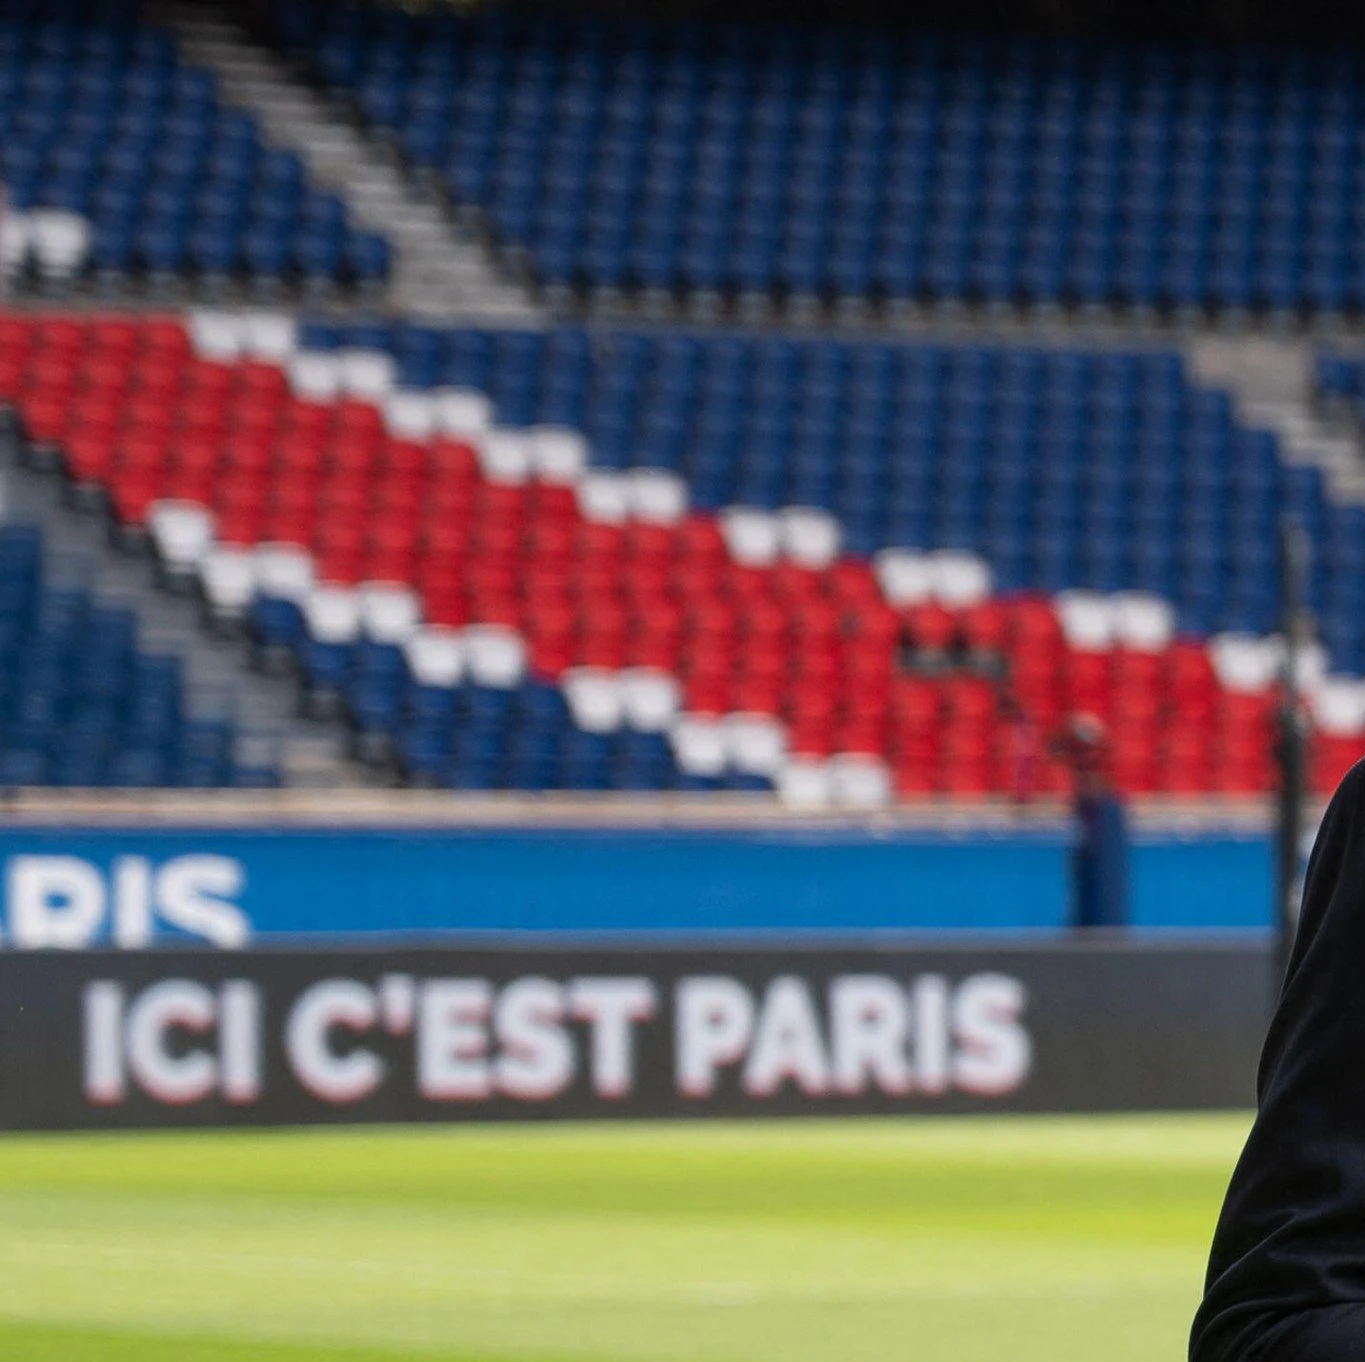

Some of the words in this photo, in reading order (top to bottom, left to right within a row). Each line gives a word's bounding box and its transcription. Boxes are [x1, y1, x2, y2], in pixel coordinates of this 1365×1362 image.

[3, 852, 253, 950] RIS
[83, 979, 262, 1104] ICI
[285, 975, 657, 1101] C'EST
[676, 972, 1030, 1099] PARIS
